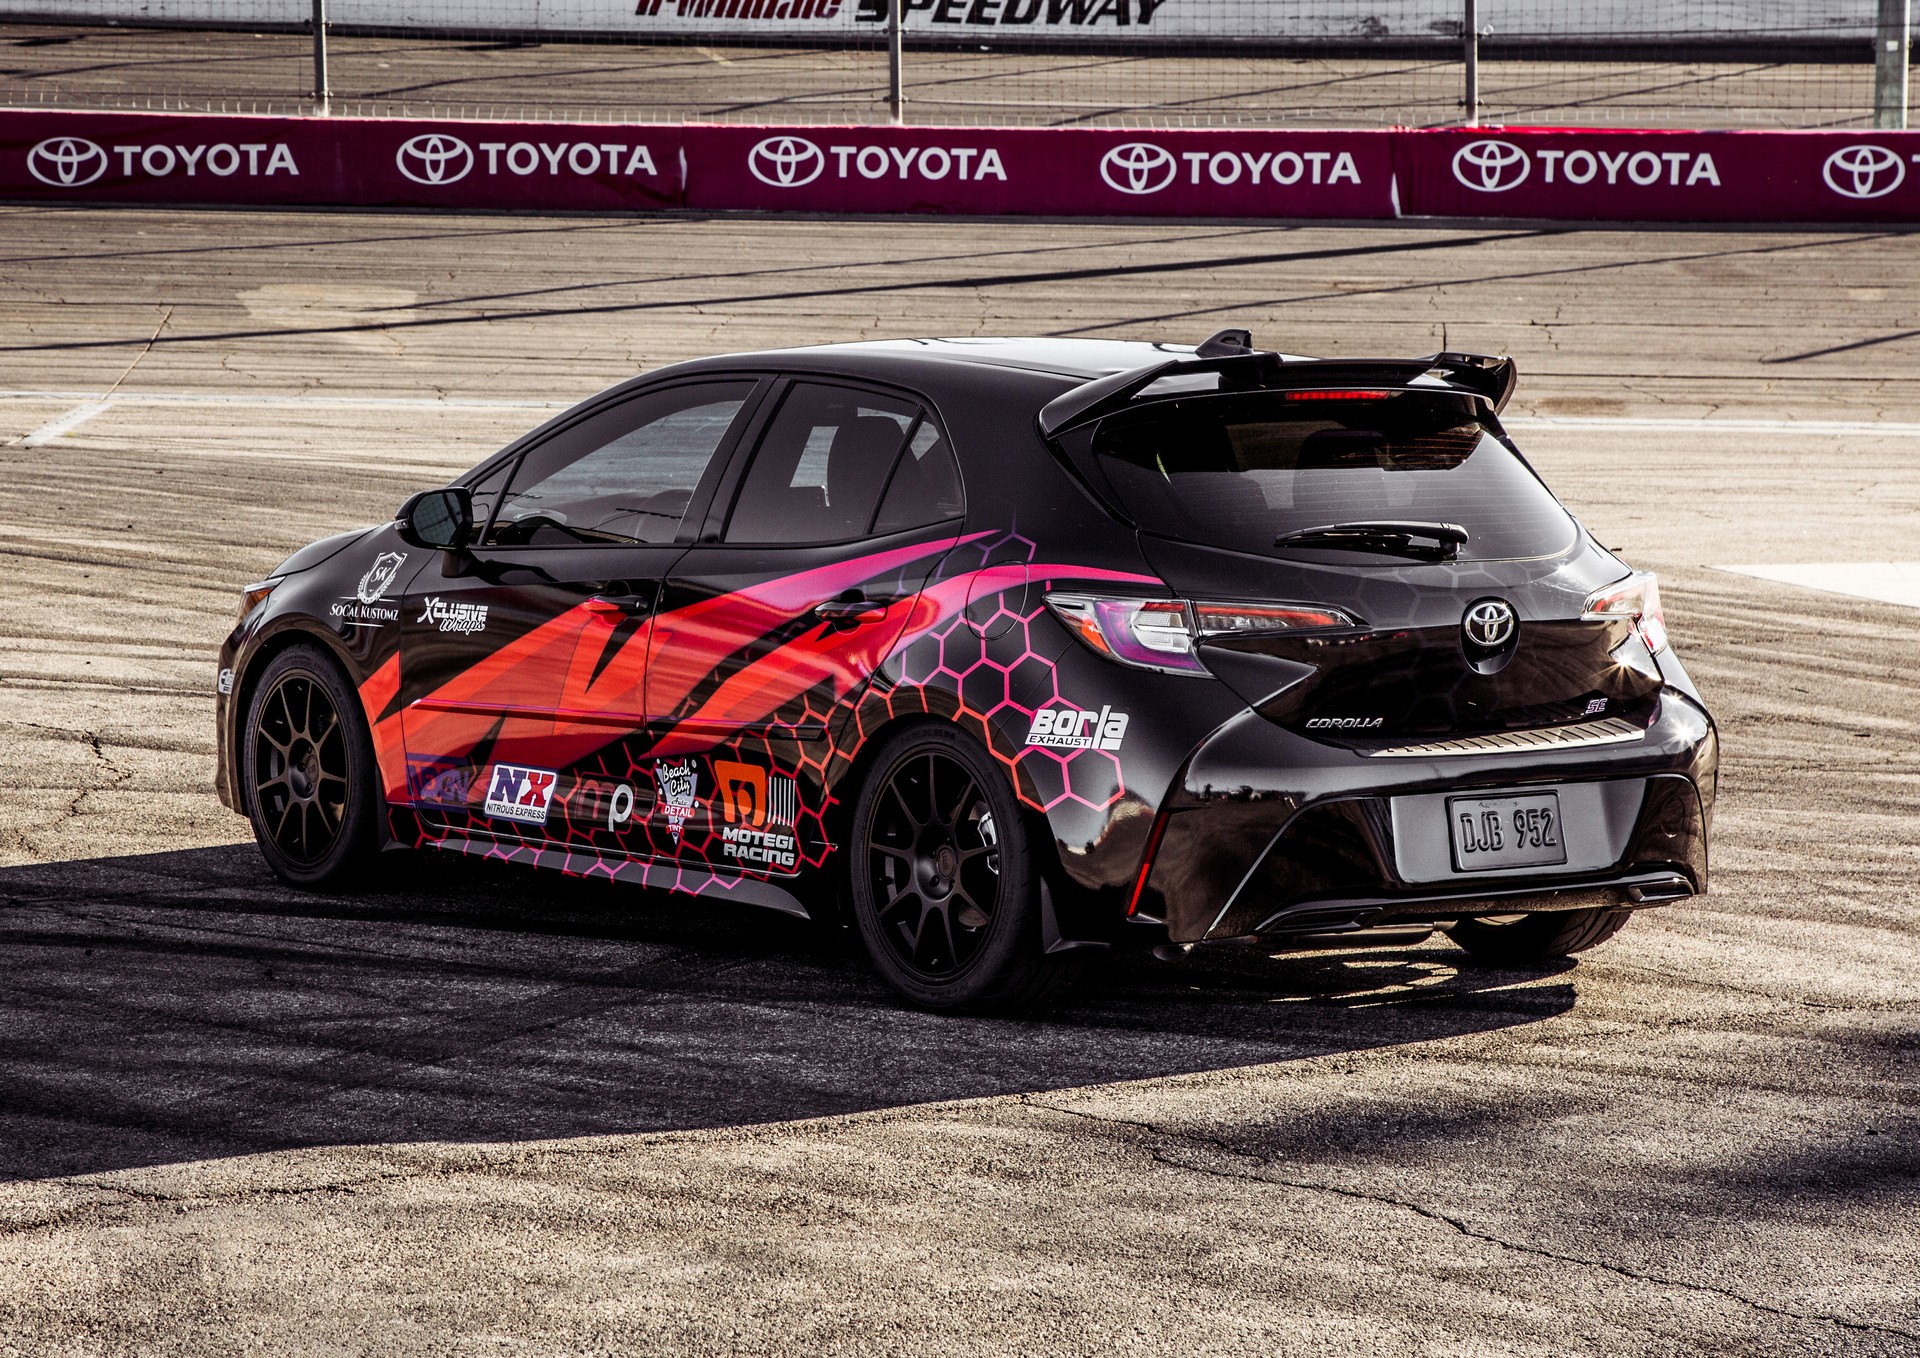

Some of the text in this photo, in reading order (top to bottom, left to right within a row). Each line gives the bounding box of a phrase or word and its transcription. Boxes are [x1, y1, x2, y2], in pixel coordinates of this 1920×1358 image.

[114, 144, 299, 176] TOYOTA
[480, 143, 657, 175] TOYOTA
[831, 146, 1007, 180] TOYOTA
[1183, 152, 1361, 184] TOYOTA
[1537, 150, 1721, 185] TOYOTA
[1585, 698, 1608, 714] SE
[1305, 717, 1384, 729] COROLLA
[1030, 735, 1090, 746] EXHAUST
[662, 759, 691, 781] Beach
[490, 767, 555, 808] NX
[670, 779, 691, 796] City
[486, 803, 546, 820] NITROUS EXPRESS
[664, 804, 693, 818] DETAIL
[668, 824, 683, 833] TINT
[722, 827, 795, 850] MOTEGI
[1460, 808, 1557, 853] DJB 952
[723, 843, 795, 867] RACING
